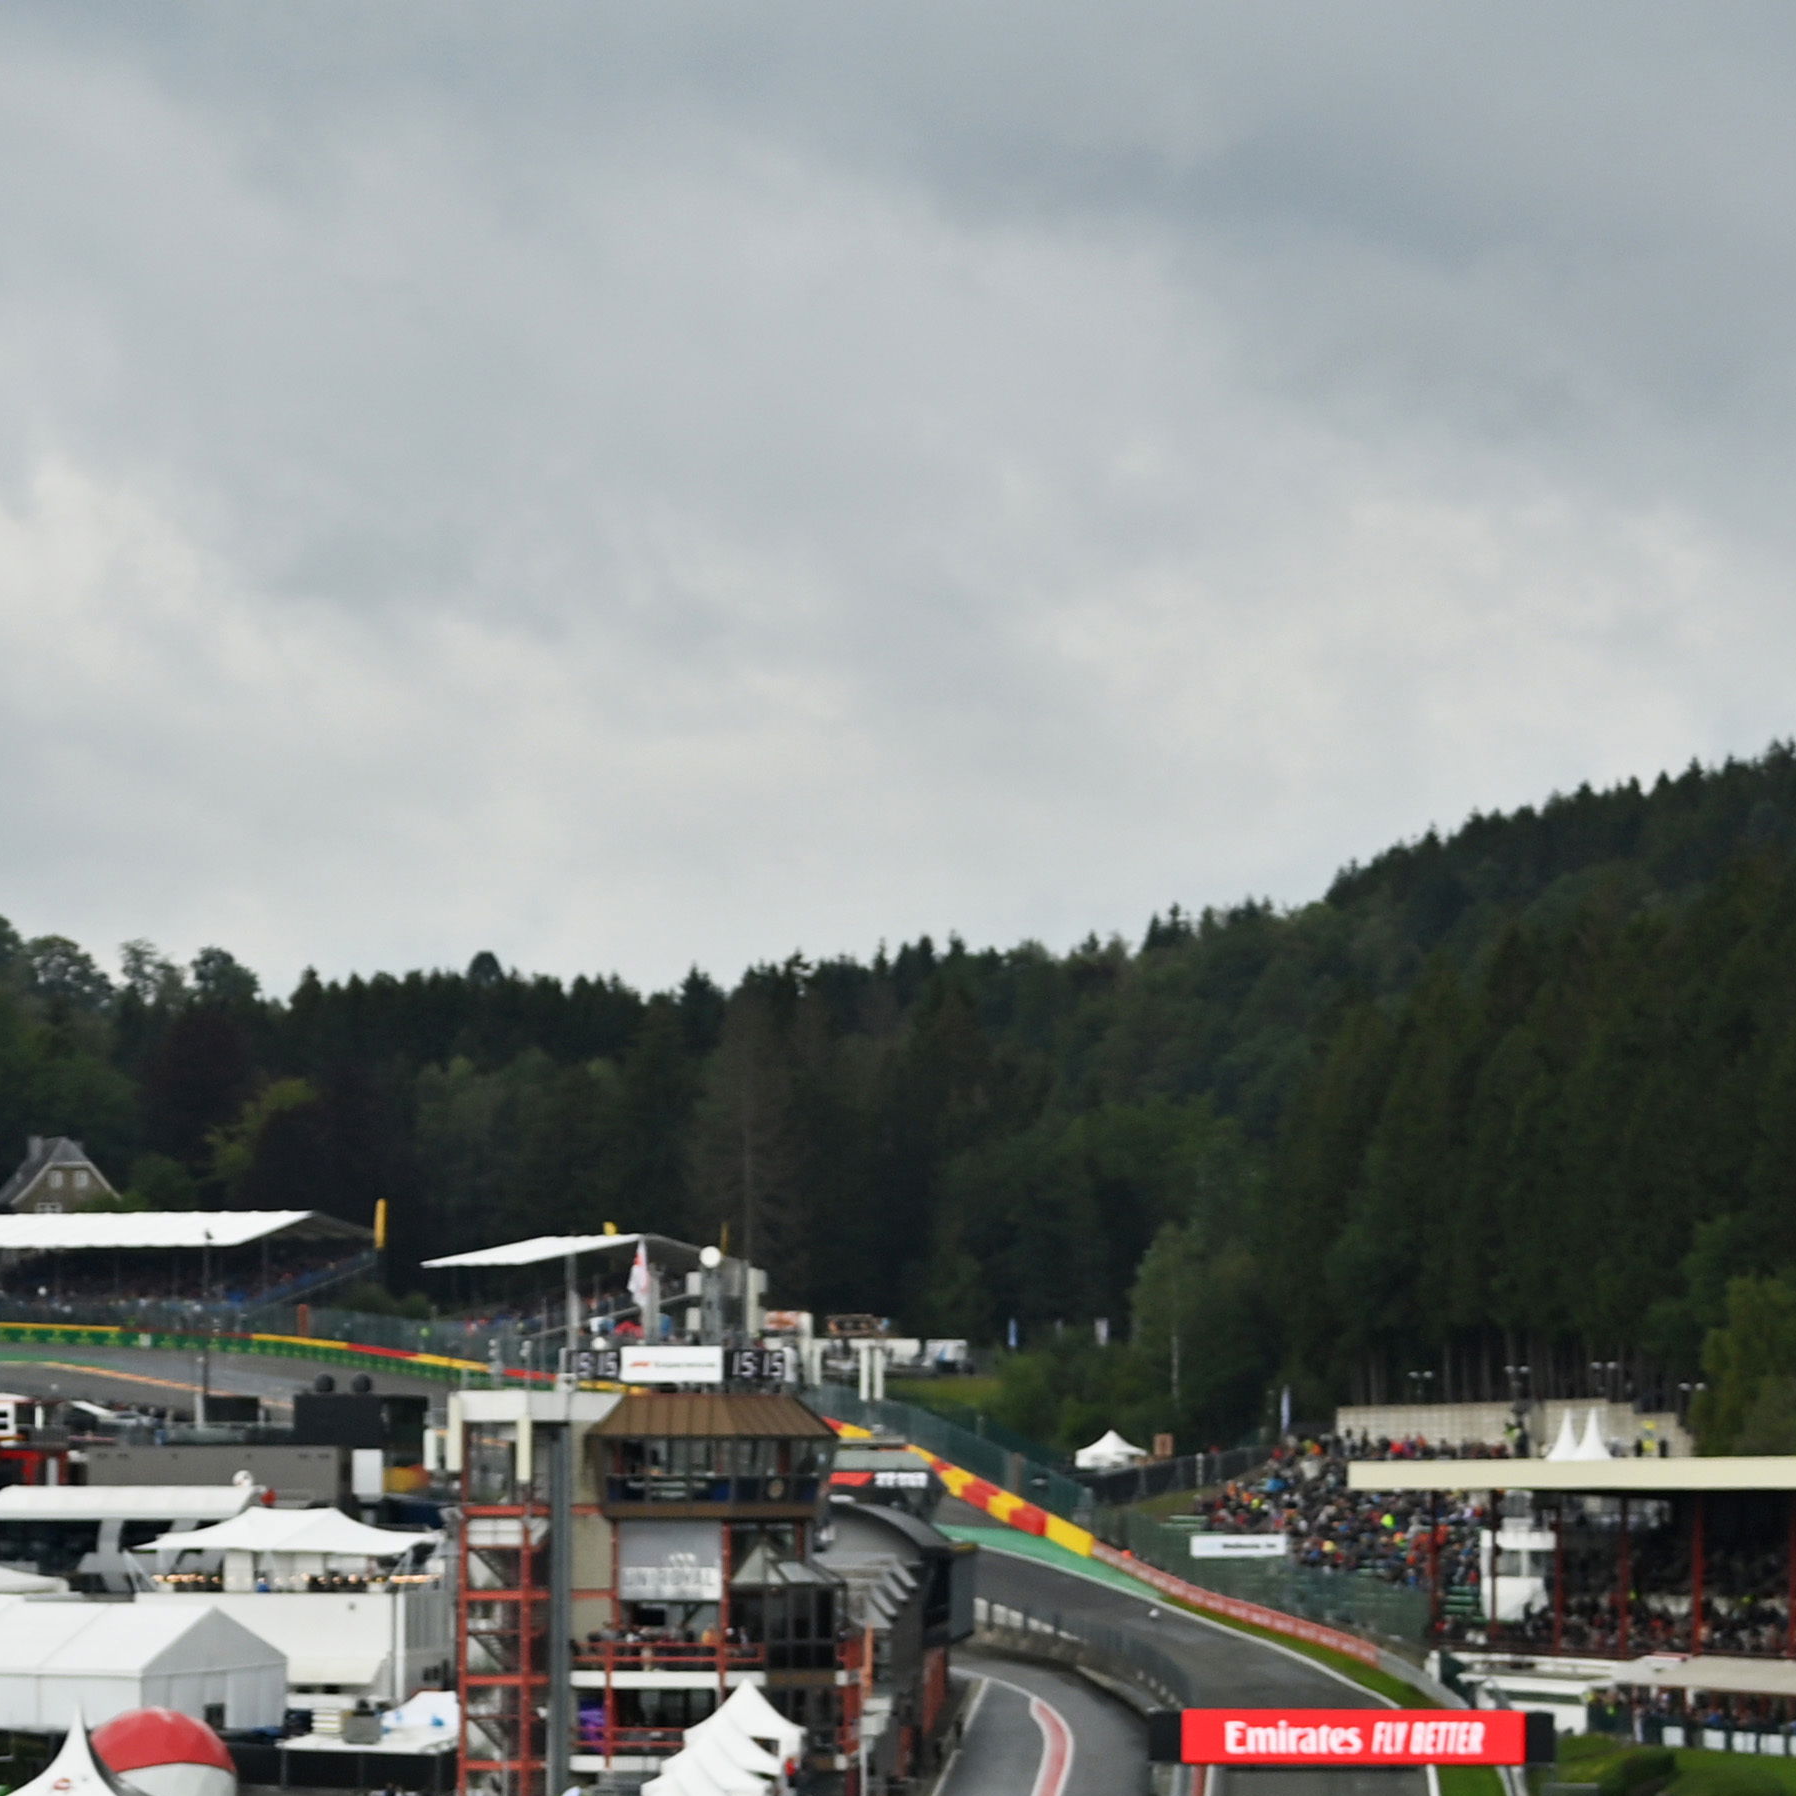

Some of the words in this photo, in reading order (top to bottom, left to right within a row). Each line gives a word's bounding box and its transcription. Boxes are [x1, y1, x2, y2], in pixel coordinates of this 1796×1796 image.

[1224, 1720, 1363, 1755] Emirates
[1371, 1721, 1407, 1755] FLY
[1409, 1721, 1484, 1755] BETTER
